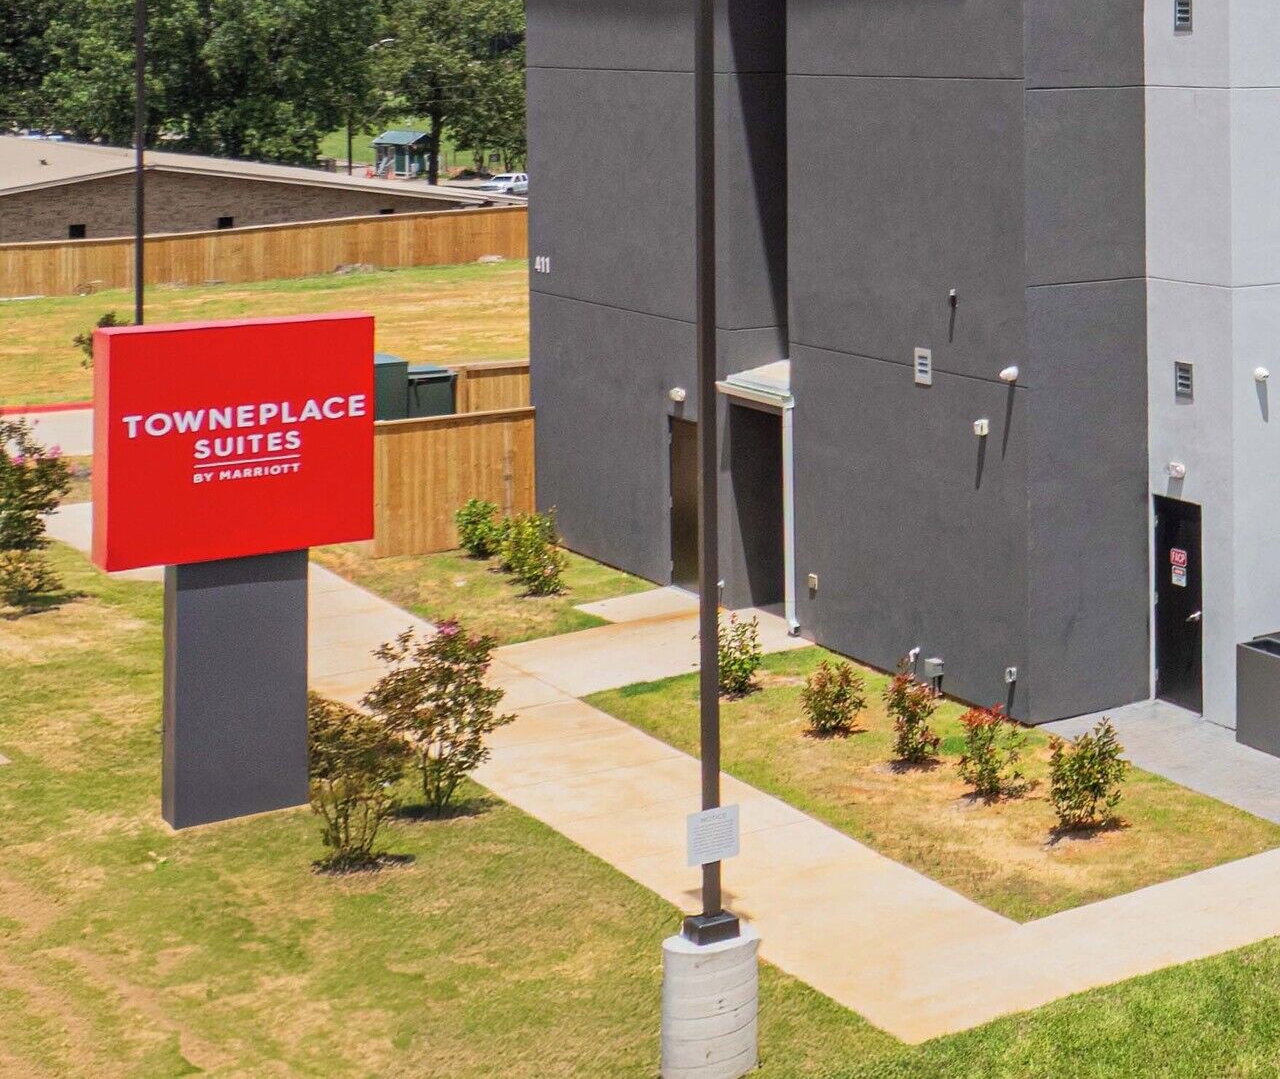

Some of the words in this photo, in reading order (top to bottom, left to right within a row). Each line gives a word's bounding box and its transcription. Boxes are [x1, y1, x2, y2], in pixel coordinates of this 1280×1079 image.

[534, 255, 551, 274] 411
[122, 393, 367, 439] TOWNEPLACE
[193, 430, 301, 460] SUITES
[192, 472, 214, 484] BY
[218, 462, 301, 482] MARRIOTT
